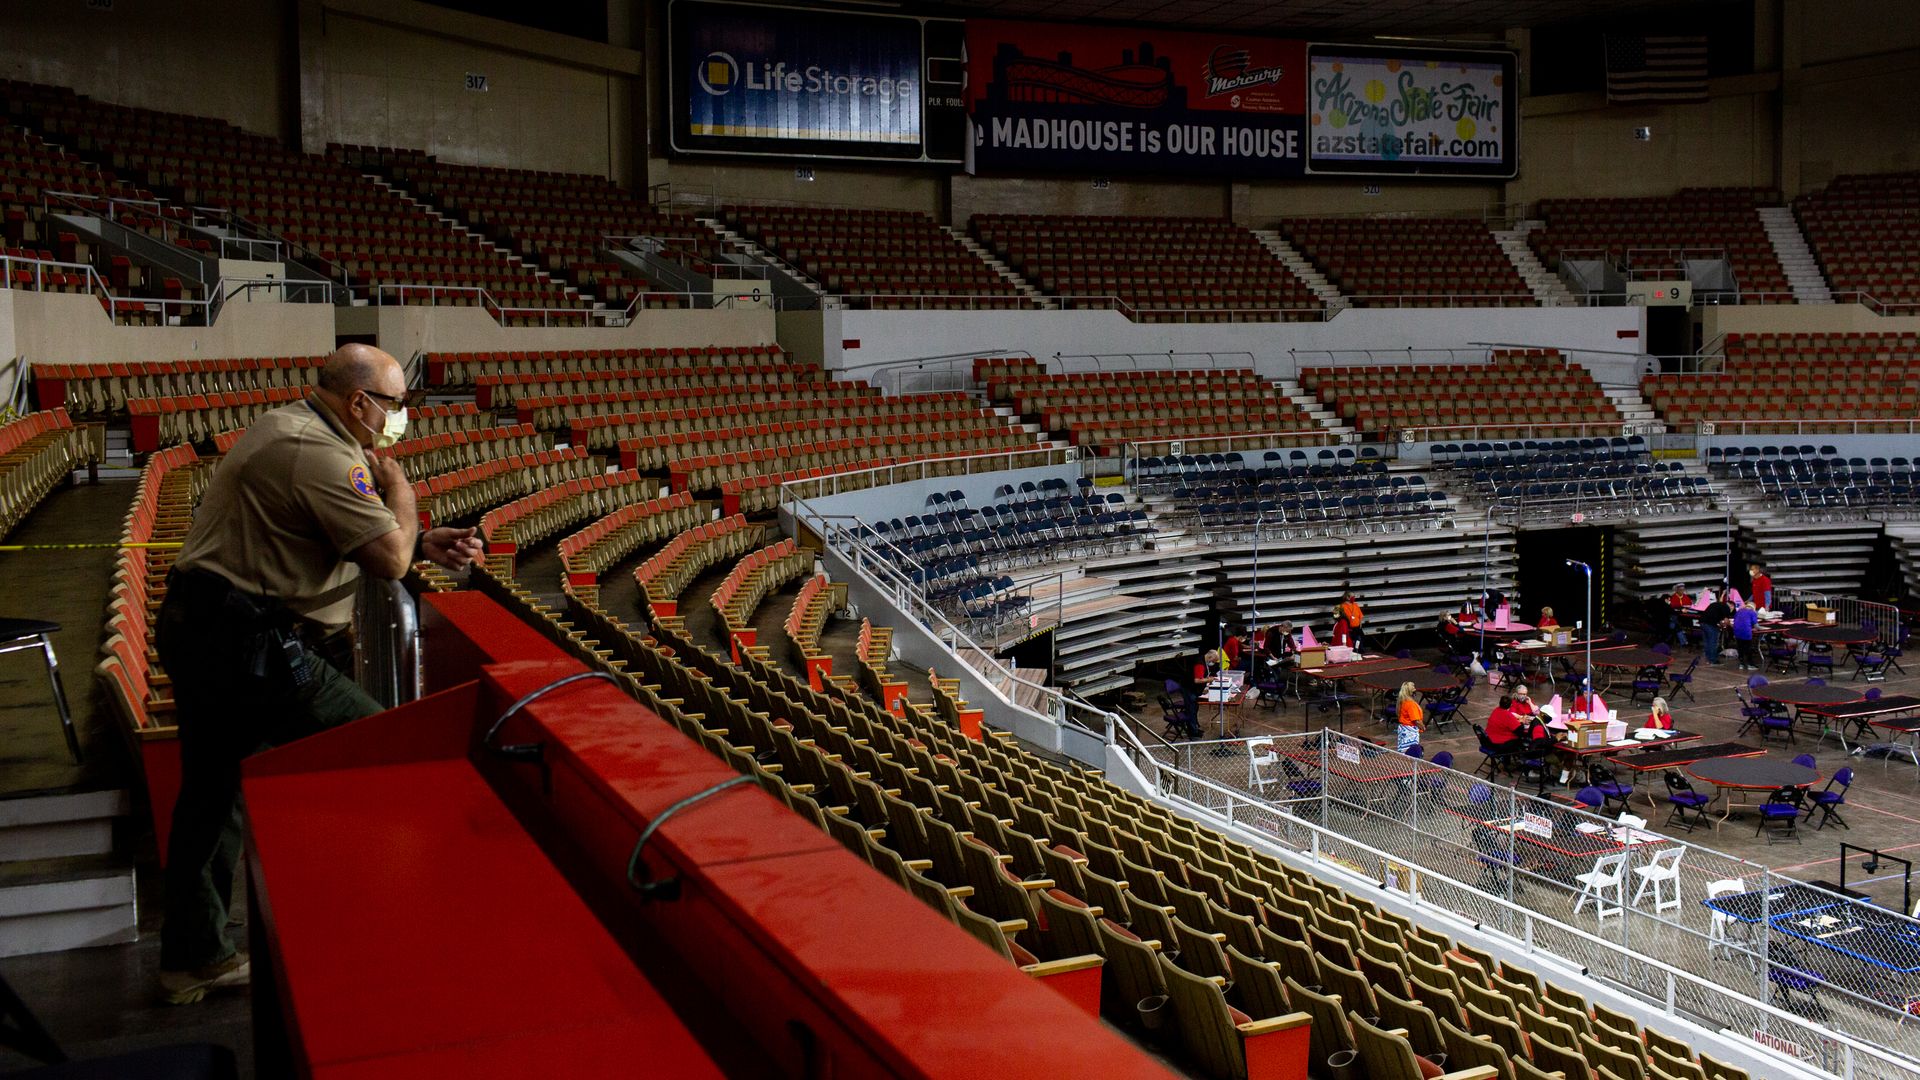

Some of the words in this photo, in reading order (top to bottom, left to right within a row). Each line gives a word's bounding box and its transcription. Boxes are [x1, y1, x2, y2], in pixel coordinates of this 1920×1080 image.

[467, 76, 485, 89] 317
[1210, 68, 1282, 94] Mercury
[1314, 72, 1391, 127] Arizona
[1391, 71, 1443, 127] State
[1440, 82, 1499, 122] Fair
[992, 117, 1133, 152] MADHOUSE
[1139, 122, 1162, 154] is
[1167, 124, 1216, 155] OUR
[1222, 126, 1299, 159] HOUSE
[1316, 131, 1499, 157] azstatefair.com
[753, 288, 761, 302] 8
[1671, 287, 1679, 299] 9
[1525, 814, 1551, 829] NATIONAL
[1754, 1030, 1799, 1057] NATIONAL
